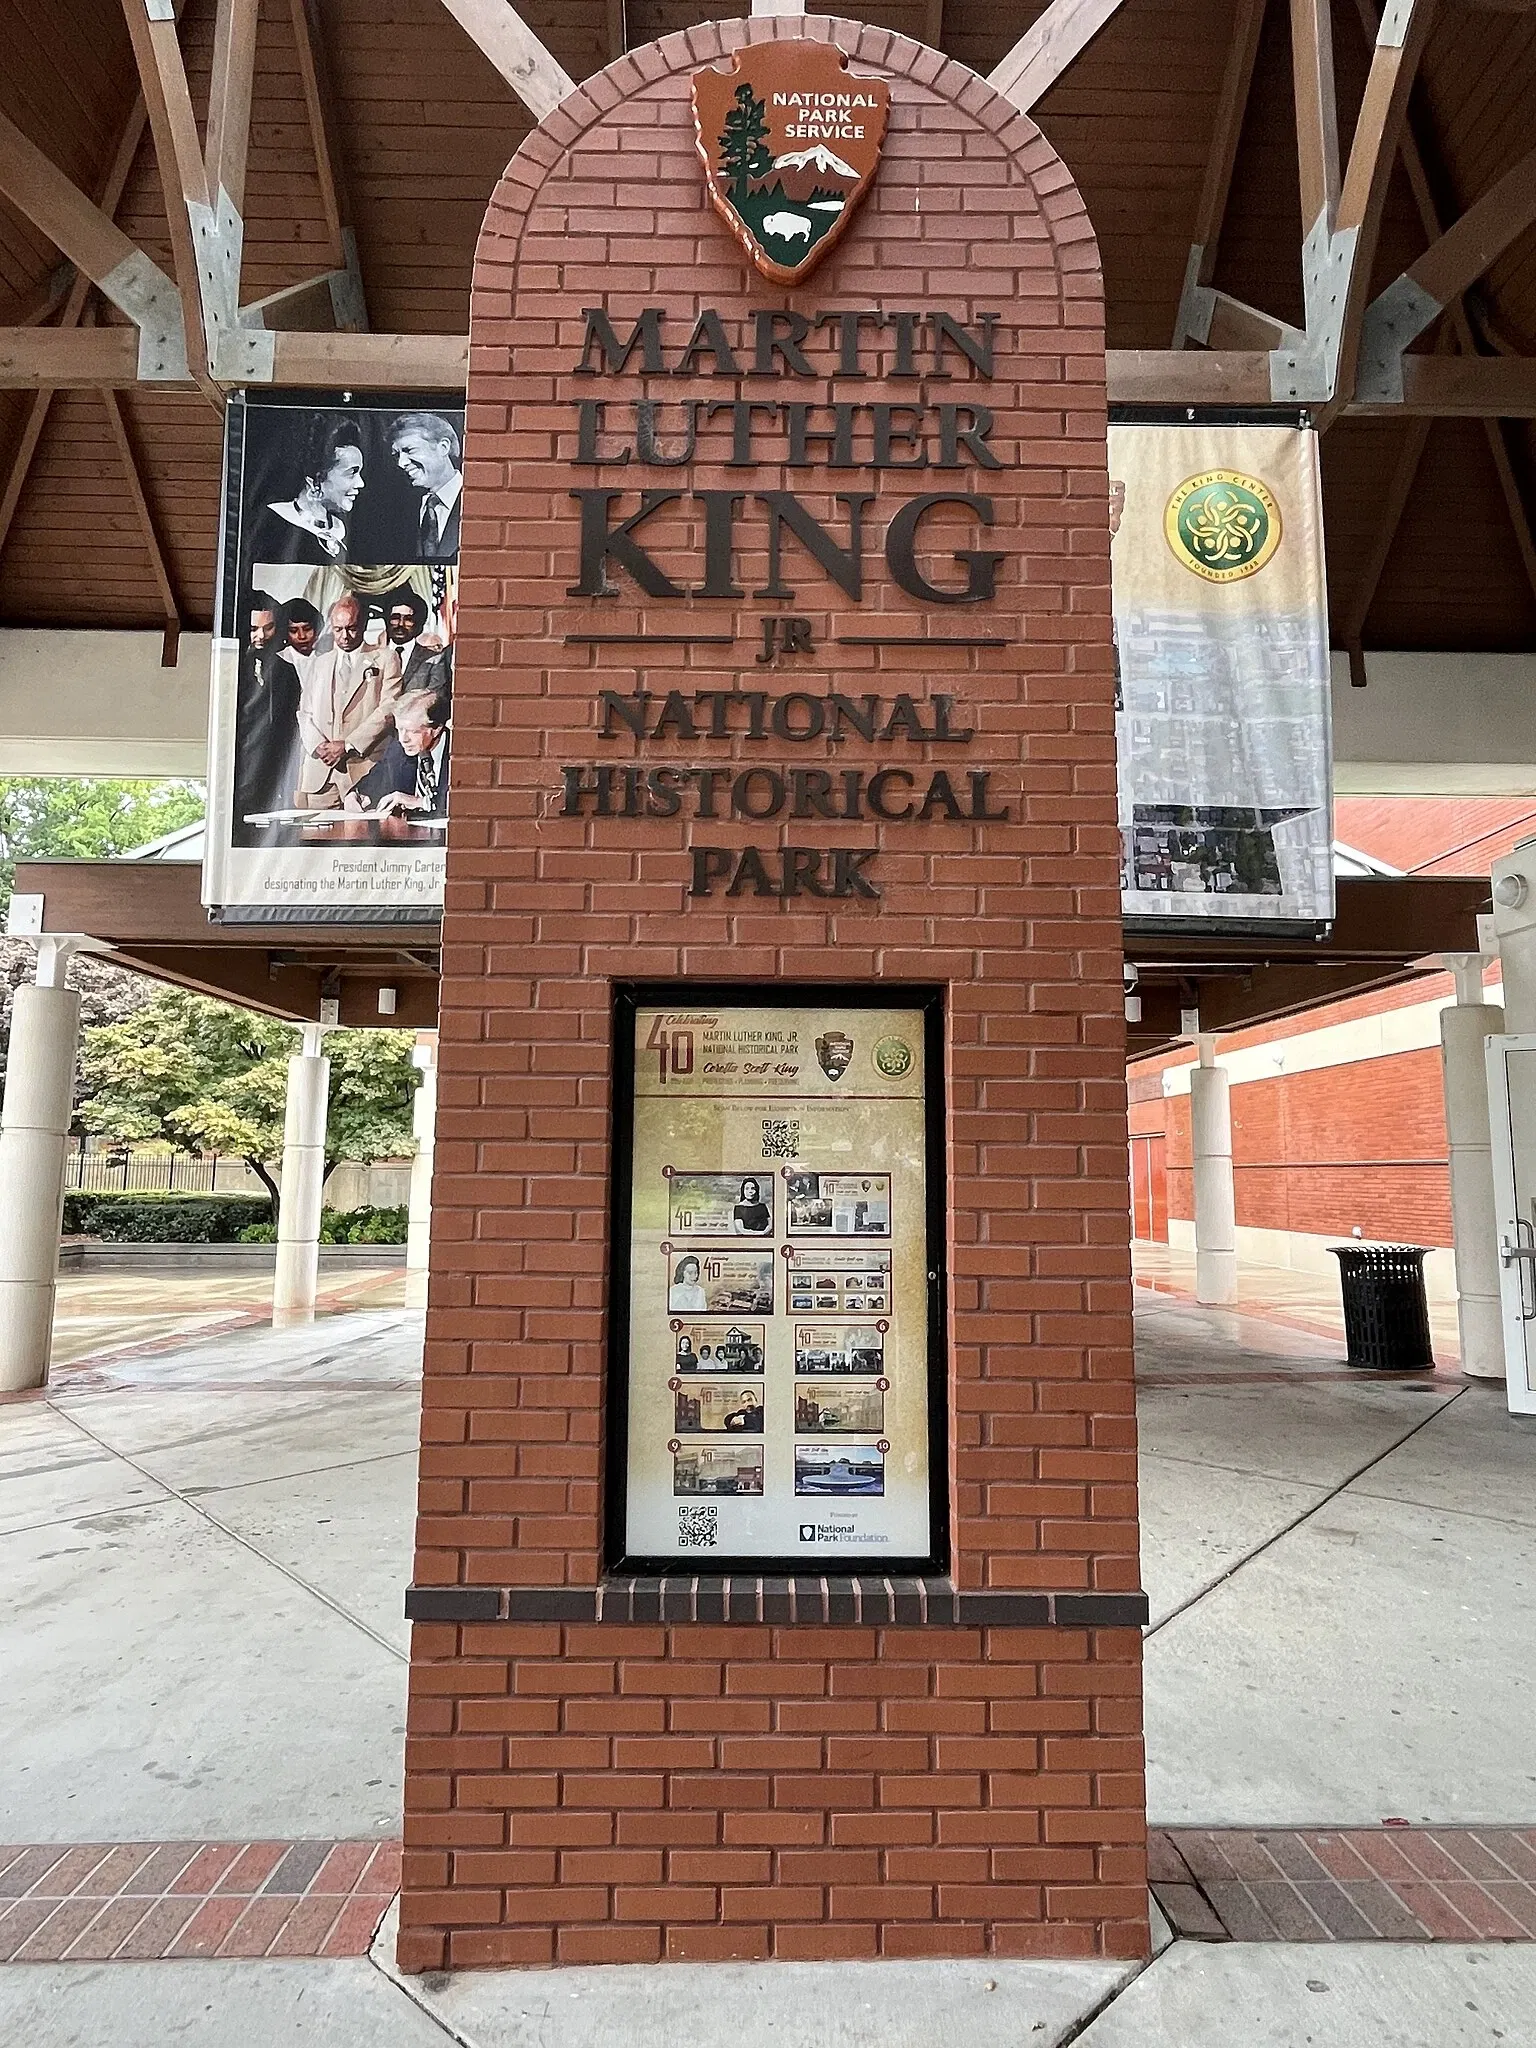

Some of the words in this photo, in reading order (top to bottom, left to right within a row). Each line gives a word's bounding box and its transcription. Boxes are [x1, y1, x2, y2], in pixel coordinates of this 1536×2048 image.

[772, 92, 878, 108] NATIONAL
[799, 108, 852, 123] PARK
[785, 124, 865, 139] SERVICE
[571, 308, 1001, 381] MARTIN
[570, 398, 1003, 470] LUTHER
[1171, 491, 1188, 509] THE
[1191, 473, 1223, 488] KING
[1233, 476, 1273, 508] CENTER
[566, 488, 1005, 603] KING
[755, 616, 816, 663] JR
[597, 689, 974, 743] NATIONAL
[559, 766, 1009, 821] HISTORICAL
[332, 860, 378, 873] President
[380, 860, 412, 876] Jimmy
[687, 845, 881, 899] PARK
[264, 877, 318, 892] designating
[320, 877, 335, 890] the
[337, 877, 368, 890] Martin
[371, 877, 402, 890] Luther
[702, 1031, 732, 1042] MARTIN
[733, 1031, 763, 1042] LUTHER
[646, 1014, 694, 1084] 40
[702, 1044, 737, 1055] NATIONAL
[738, 1044, 778, 1055] HISTORICAL
[780, 1044, 799, 1055] PARK
[703, 1062, 738, 1074] Coretta
[743, 1062, 770, 1074] Scott
[773, 1062, 800, 1077] King
[879, 1321, 886, 1331] 6
[879, 1380, 886, 1389] 8
[671, 1441, 678, 1450] 9
[878, 1442, 888, 1450] 10
[817, 1524, 855, 1533] National
[817, 1533, 839, 1542] Park
[840, 1533, 889, 1542] Foundation
